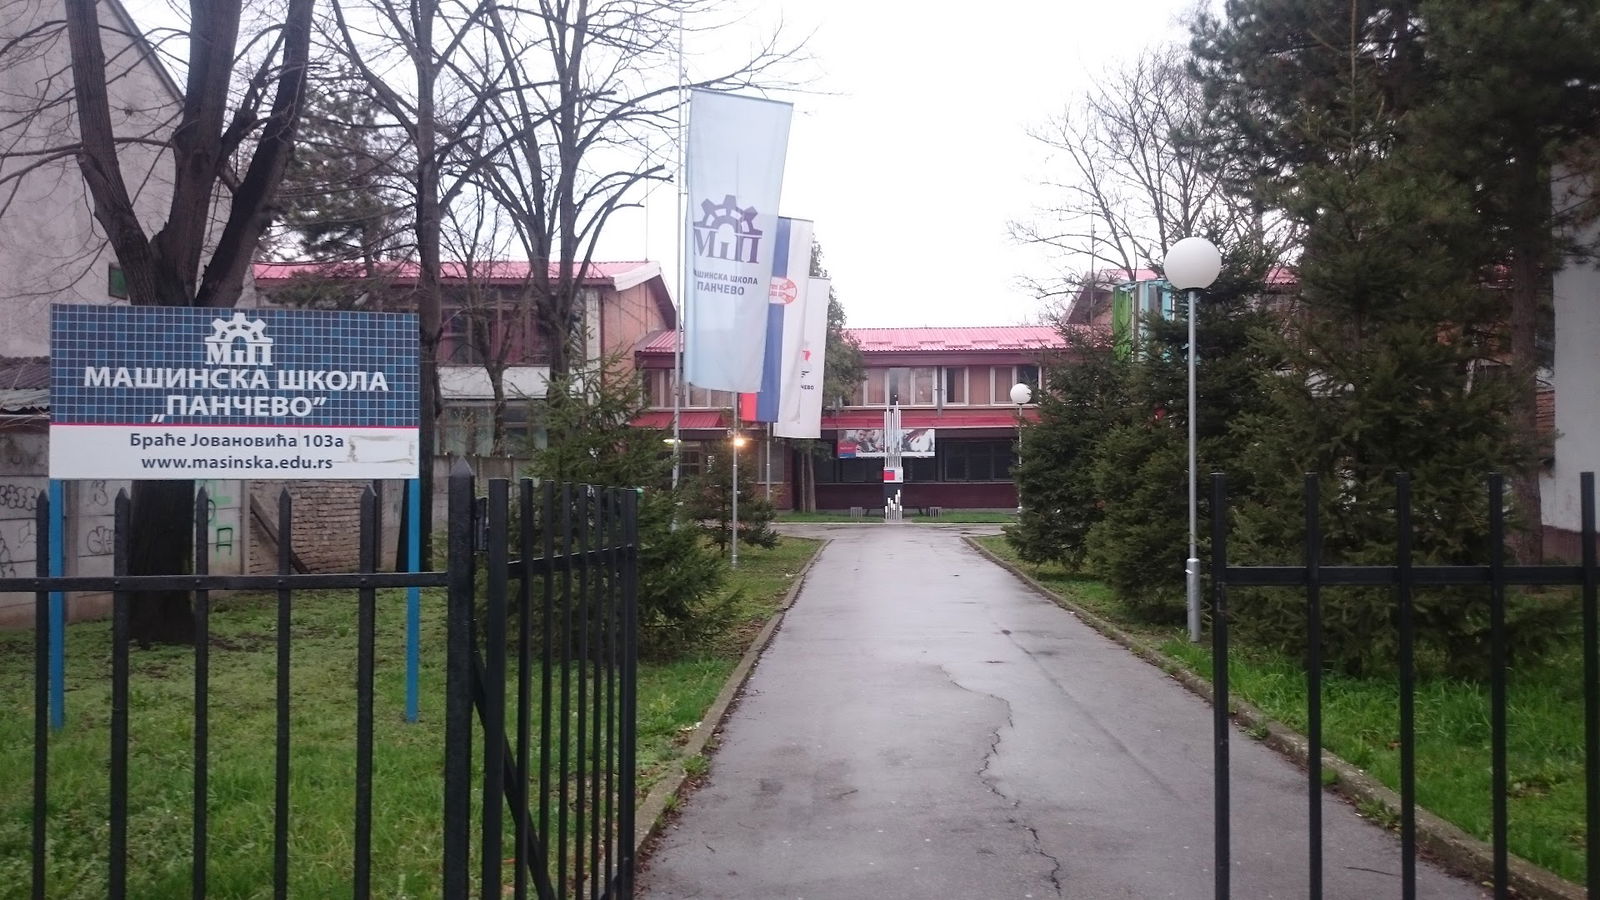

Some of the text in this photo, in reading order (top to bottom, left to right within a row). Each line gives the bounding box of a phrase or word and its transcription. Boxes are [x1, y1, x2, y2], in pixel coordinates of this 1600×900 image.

[730, 274, 758, 285] ШКОЛА
[697, 281, 745, 296] ПАНЧЕВО
[84, 366, 389, 391] МАШИНСКА ШКОЛА
[130, 432, 344, 449] Браће Јовановића 103а
[142, 455, 333, 469] www.masinska.edu.rs
